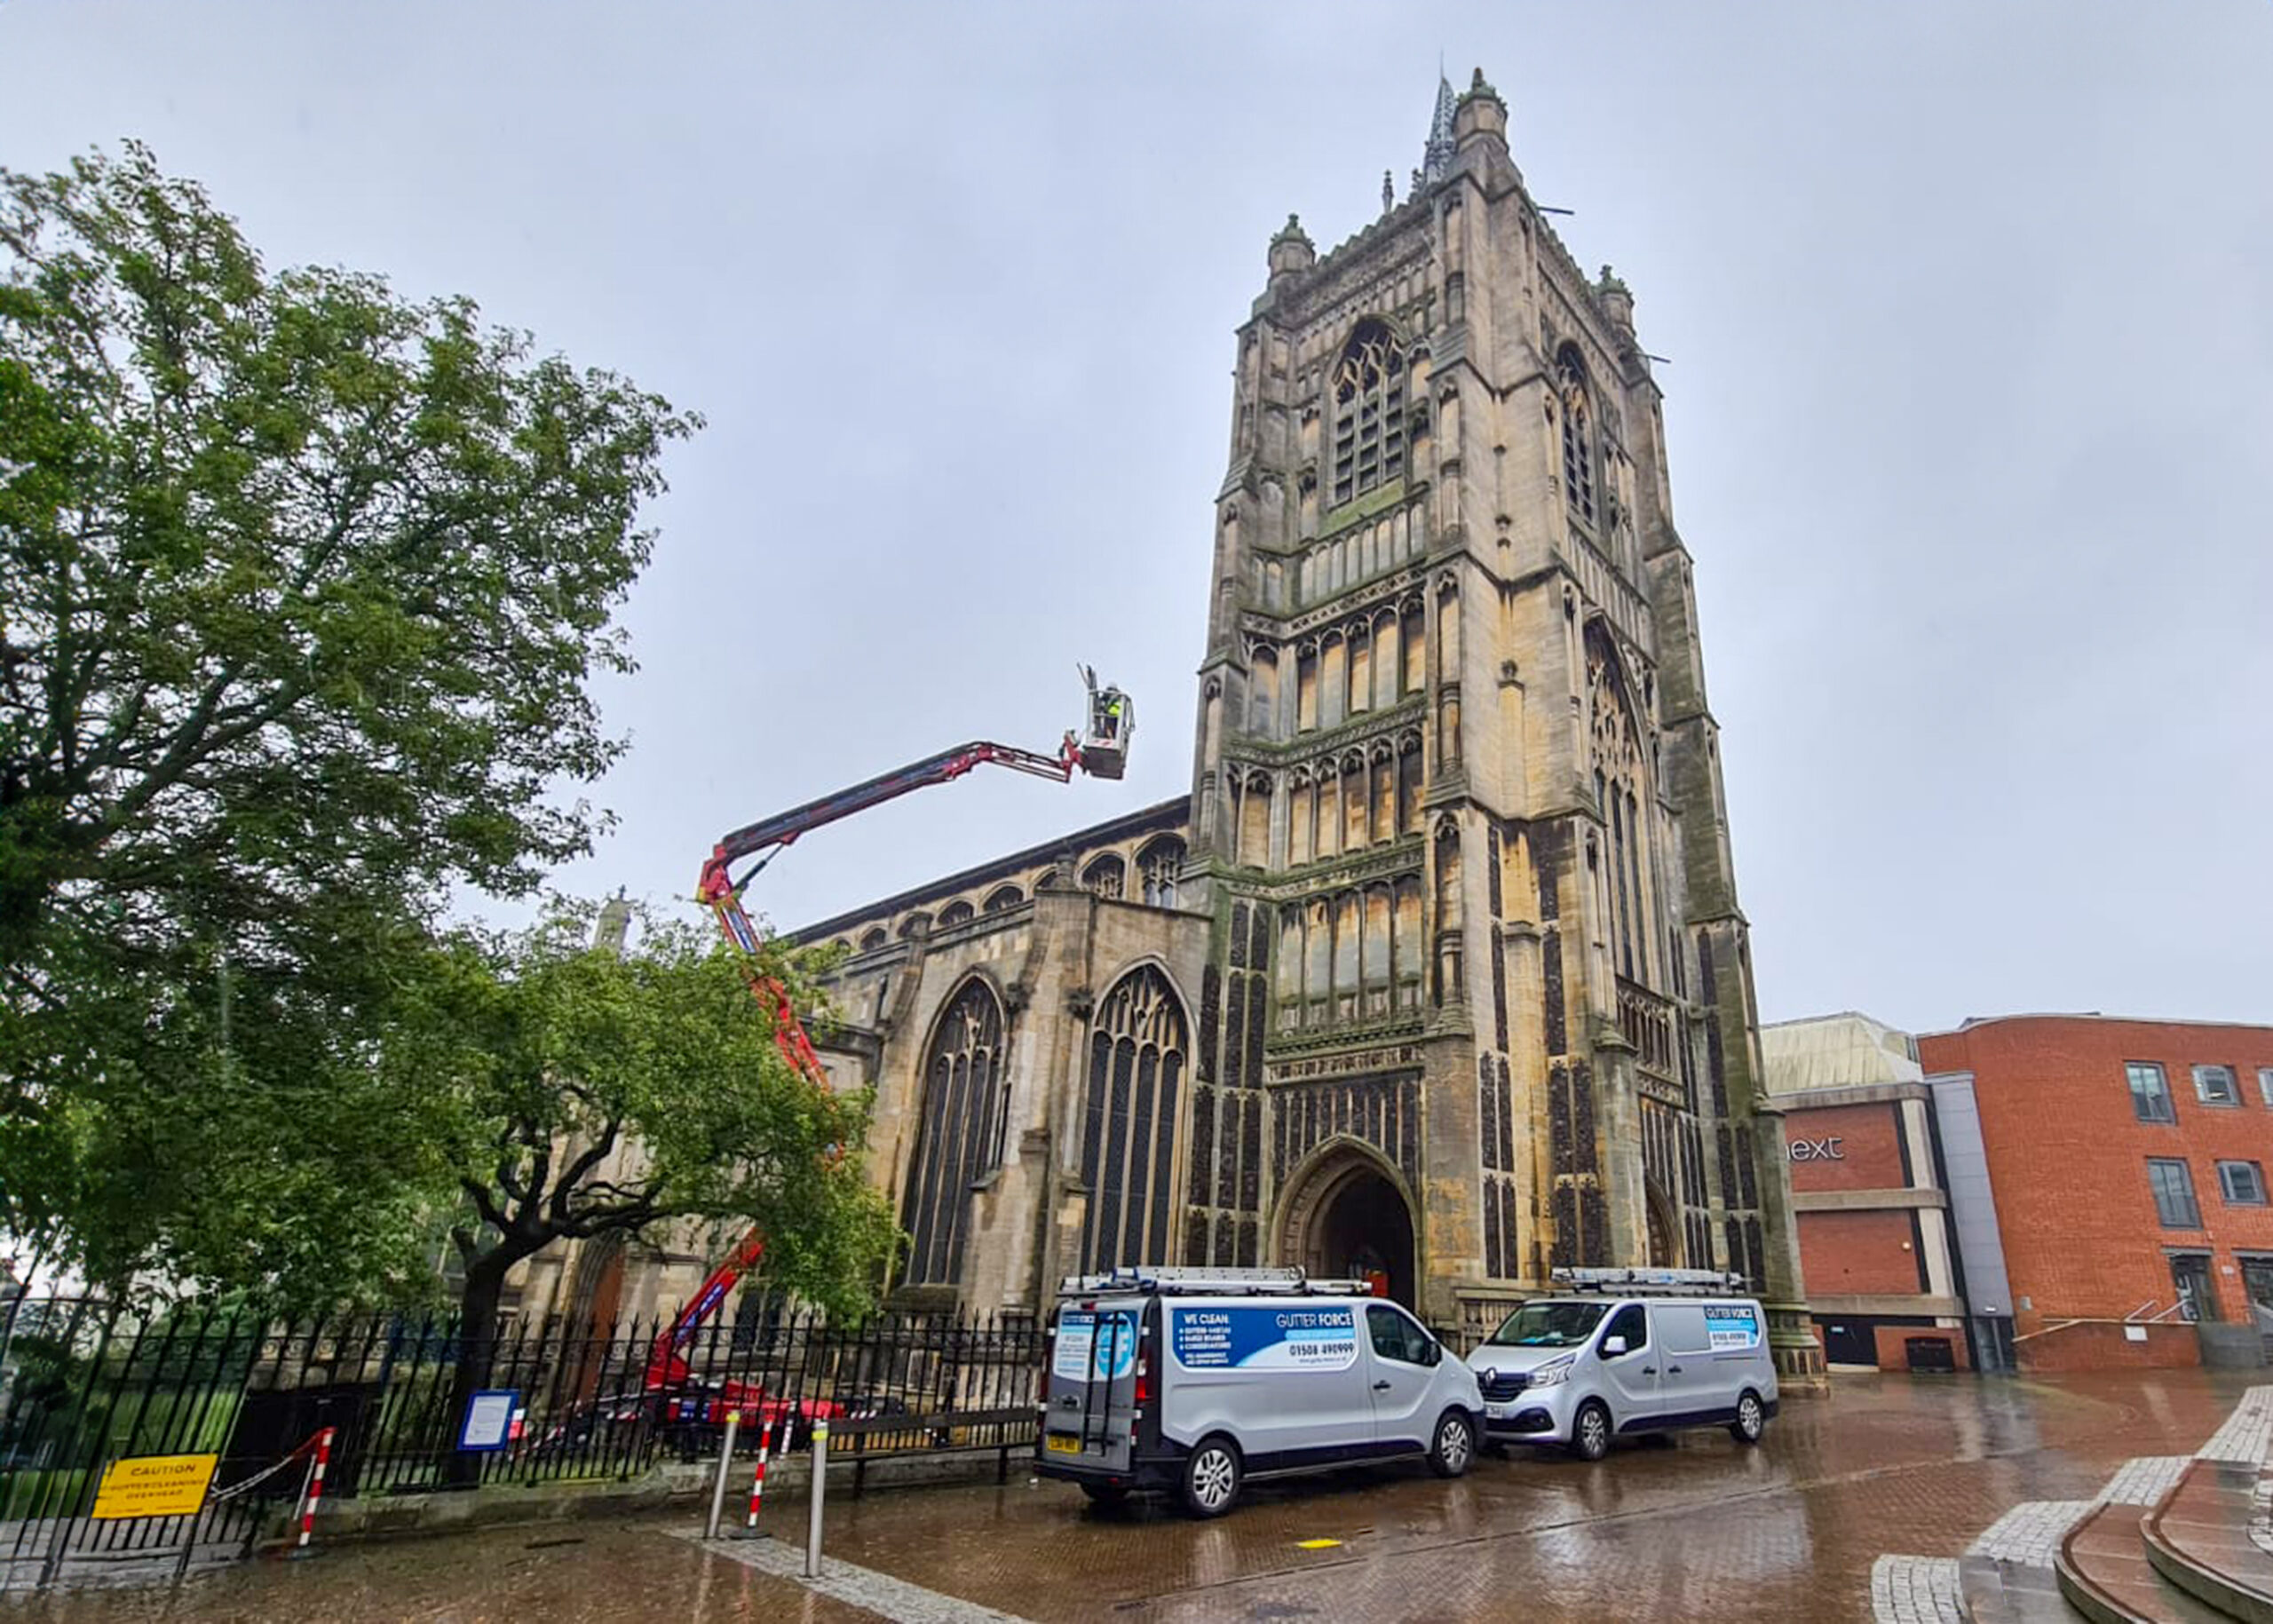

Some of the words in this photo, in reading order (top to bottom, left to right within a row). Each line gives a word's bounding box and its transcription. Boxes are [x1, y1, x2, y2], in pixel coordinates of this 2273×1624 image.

[1184, 1313, 1197, 1325] WE
[1199, 1313, 1229, 1324] CLEAN
[1276, 1313, 1317, 1327] GUTTER
[1318, 1312, 1352, 1327] FORCE
[1289, 1344, 1318, 1357] 01508
[1321, 1342, 1354, 1355] 490999
[131, 1464, 196, 1477] CAUTION
